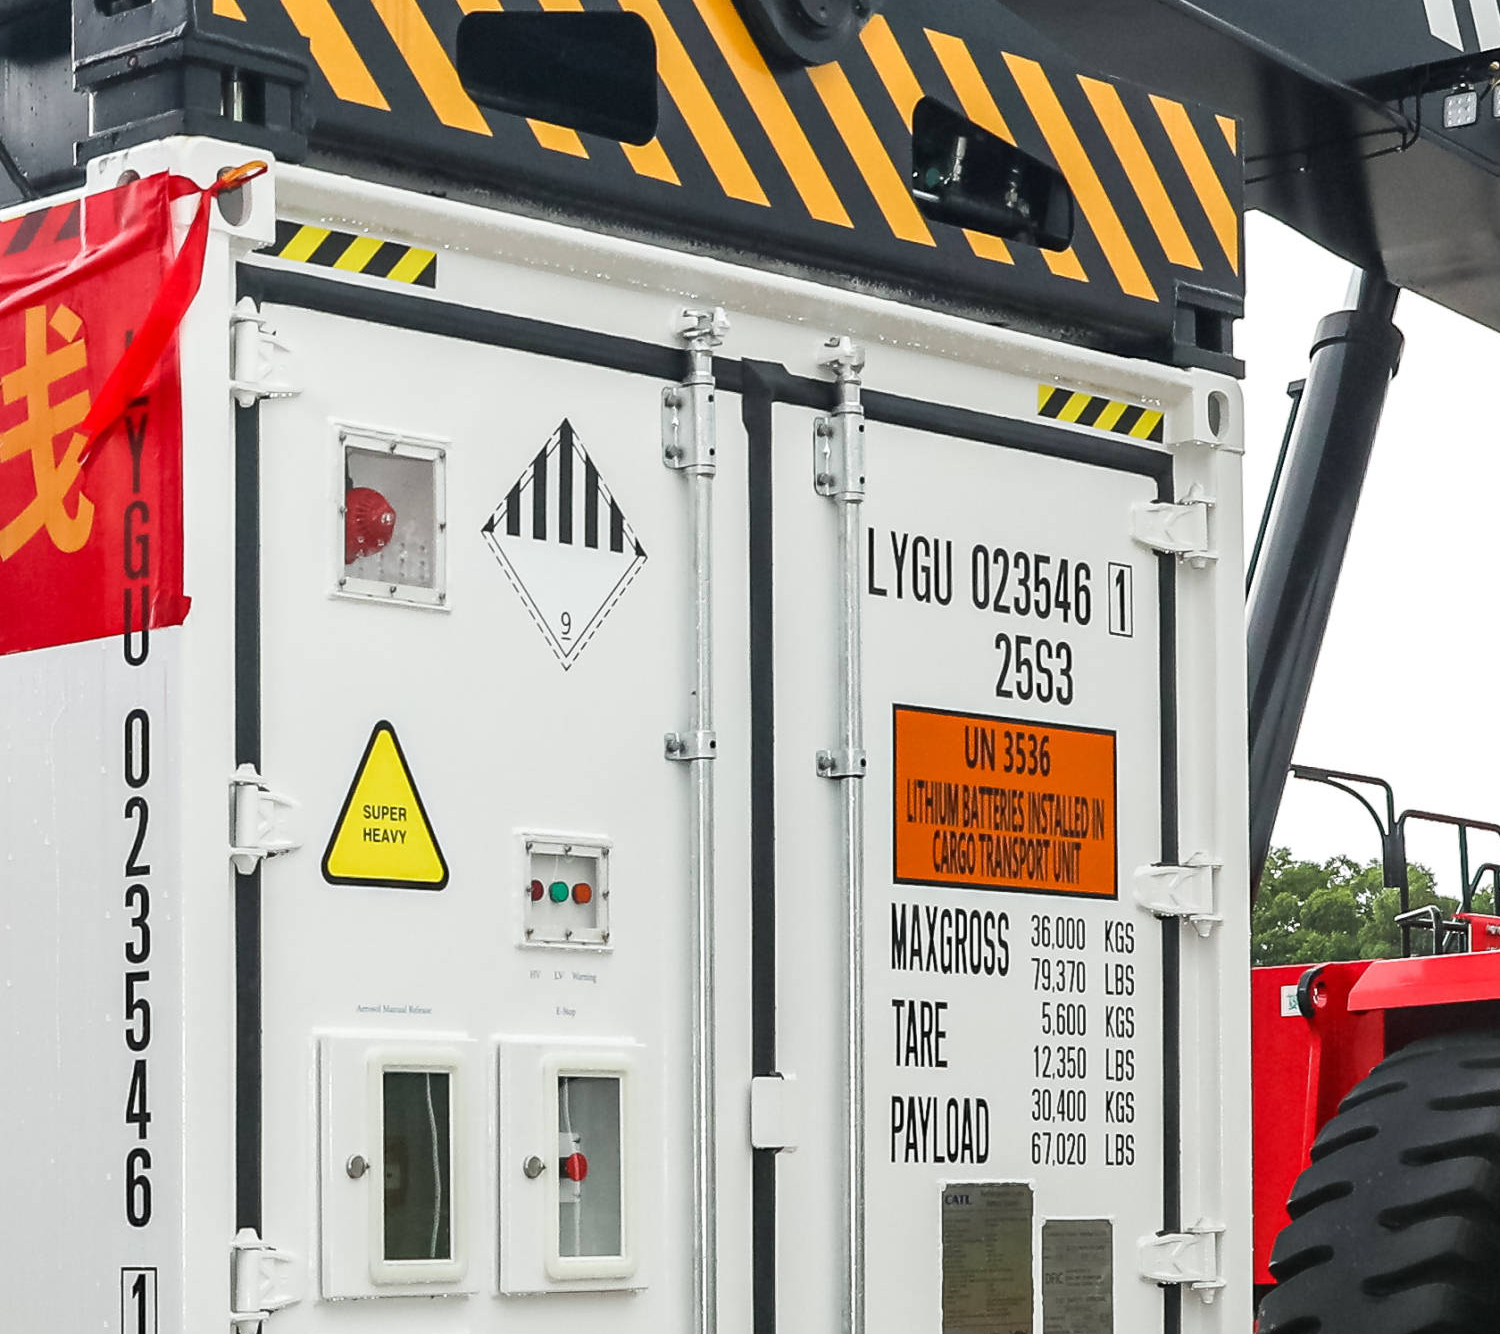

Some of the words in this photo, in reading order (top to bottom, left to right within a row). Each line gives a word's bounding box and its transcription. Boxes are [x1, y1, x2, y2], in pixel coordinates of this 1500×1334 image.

[867, 527, 953, 606] LYGU
[971, 544, 1092, 626] 023546
[560, 611, 571, 635] 9
[994, 632, 1074, 706] 25S3
[964, 725, 996, 771] UN
[1003, 730, 1051, 777] 3536
[362, 804, 407, 822] SUPER
[362, 828, 407, 844] HEAVY
[906, 778, 959, 828] LITHIUM
[963, 785, 1024, 833] BATTERIES
[1028, 791, 1089, 840] INSTALLED
[1092, 798, 1105, 841] IN
[932, 830, 976, 876] CARGO
[978, 833, 1051, 882] TRANSPORT
[1053, 841, 1082, 885] UNIT
[891, 902, 1010, 977] MAXGROSS
[1031, 914, 1086, 950] 36,000
[1104, 919, 1135, 954] KGS
[124, 708, 152, 1228] 023546
[1031, 957, 1086, 994] 79,370
[1104, 962, 1135, 997] LBS
[891, 998, 948, 1068] TARE
[1041, 1001, 1087, 1037] 5,600
[1105, 1005, 1135, 1039] KGS
[1033, 1045, 1087, 1080] 12,350
[1105, 1048, 1135, 1082] LBS
[890, 1095, 990, 1164] PAYLOAD
[1031, 1088, 1087, 1123] 30,400
[1105, 1090, 1135, 1124] KGS
[1031, 1131, 1087, 1167] 67,020
[1104, 1133, 1135, 1167] LBS
